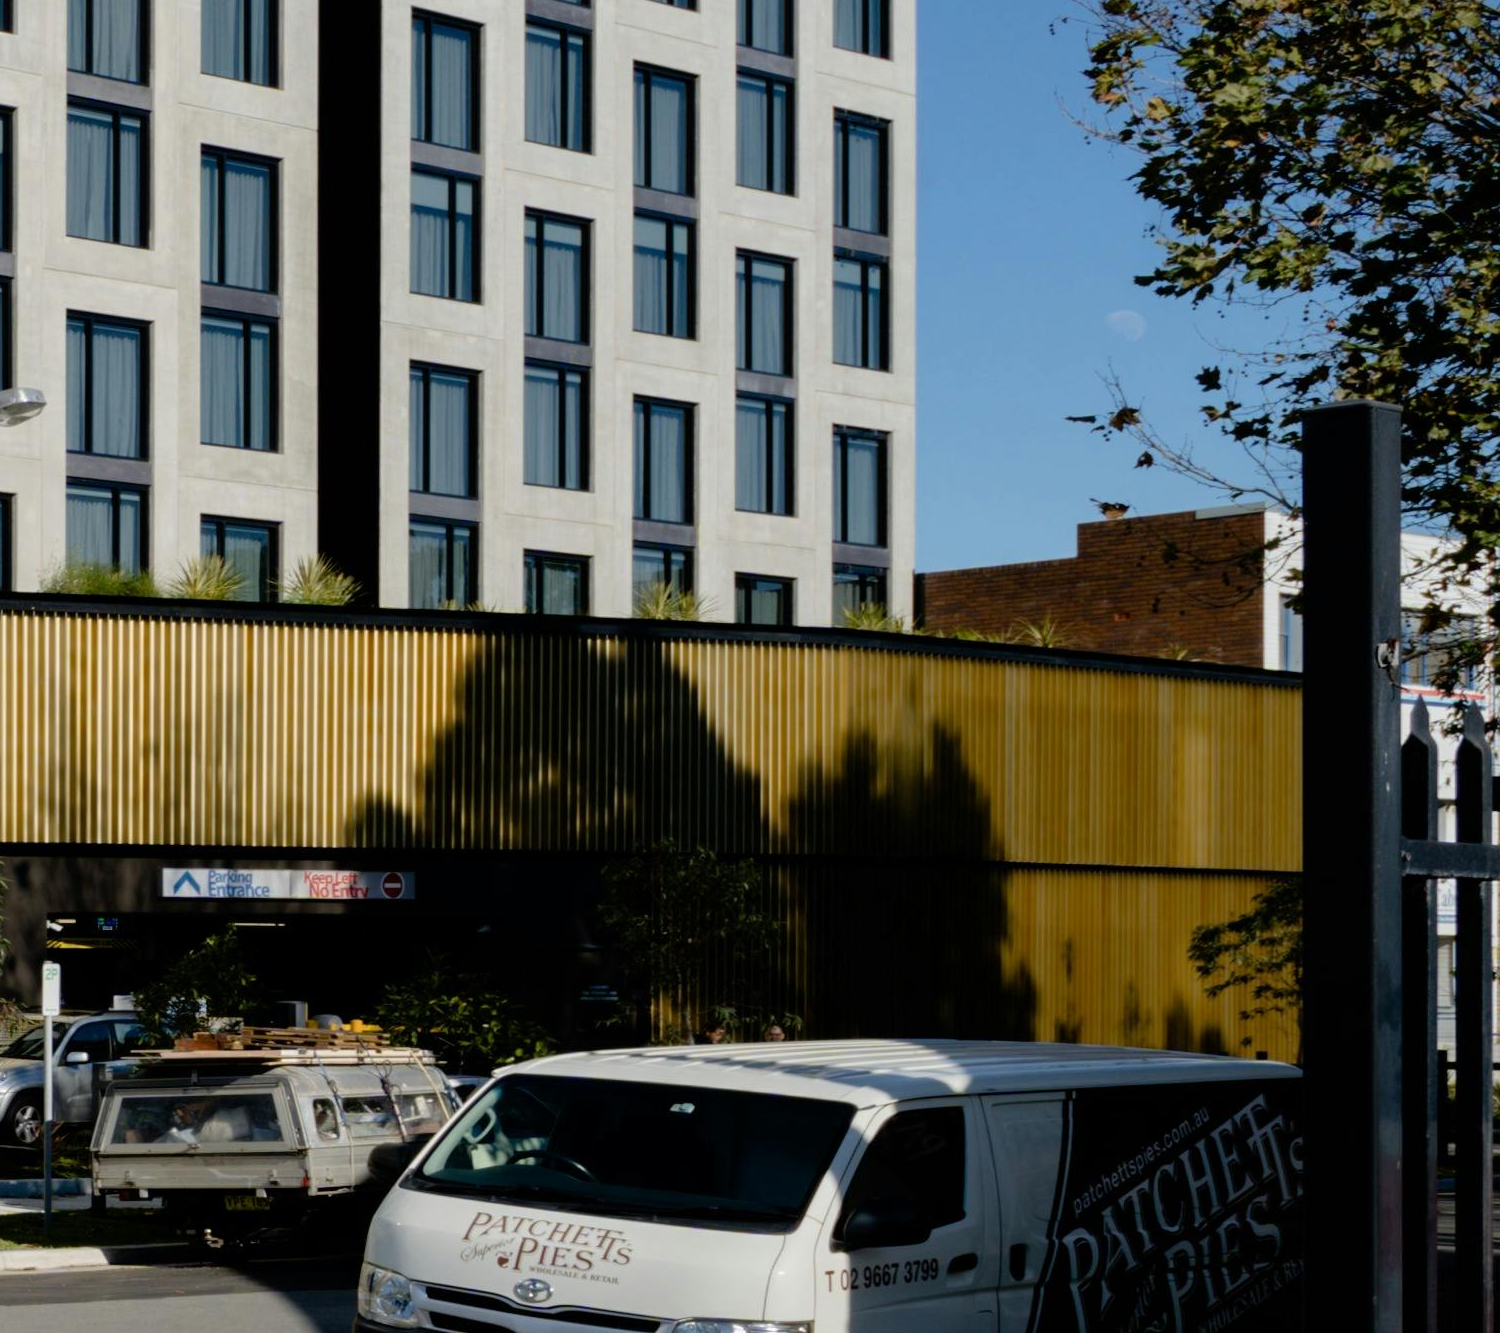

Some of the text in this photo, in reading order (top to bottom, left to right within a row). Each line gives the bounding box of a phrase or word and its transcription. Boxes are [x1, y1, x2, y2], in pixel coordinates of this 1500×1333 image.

[208, 869, 253, 885] Parking
[303, 871, 358, 887] Keep Left
[208, 883, 270, 897] Entrance
[309, 884, 369, 900] No Entry
[1073, 1107, 1210, 1215] patchettspies.com.au
[513, 1237, 594, 1273] PIES
[1164, 1194, 1281, 1333] PIES
[529, 1265, 578, 1279] WHOLESALE
[590, 1273, 620, 1285] RETAIL
[825, 1258, 939, 1293] T 02 9667 3799
